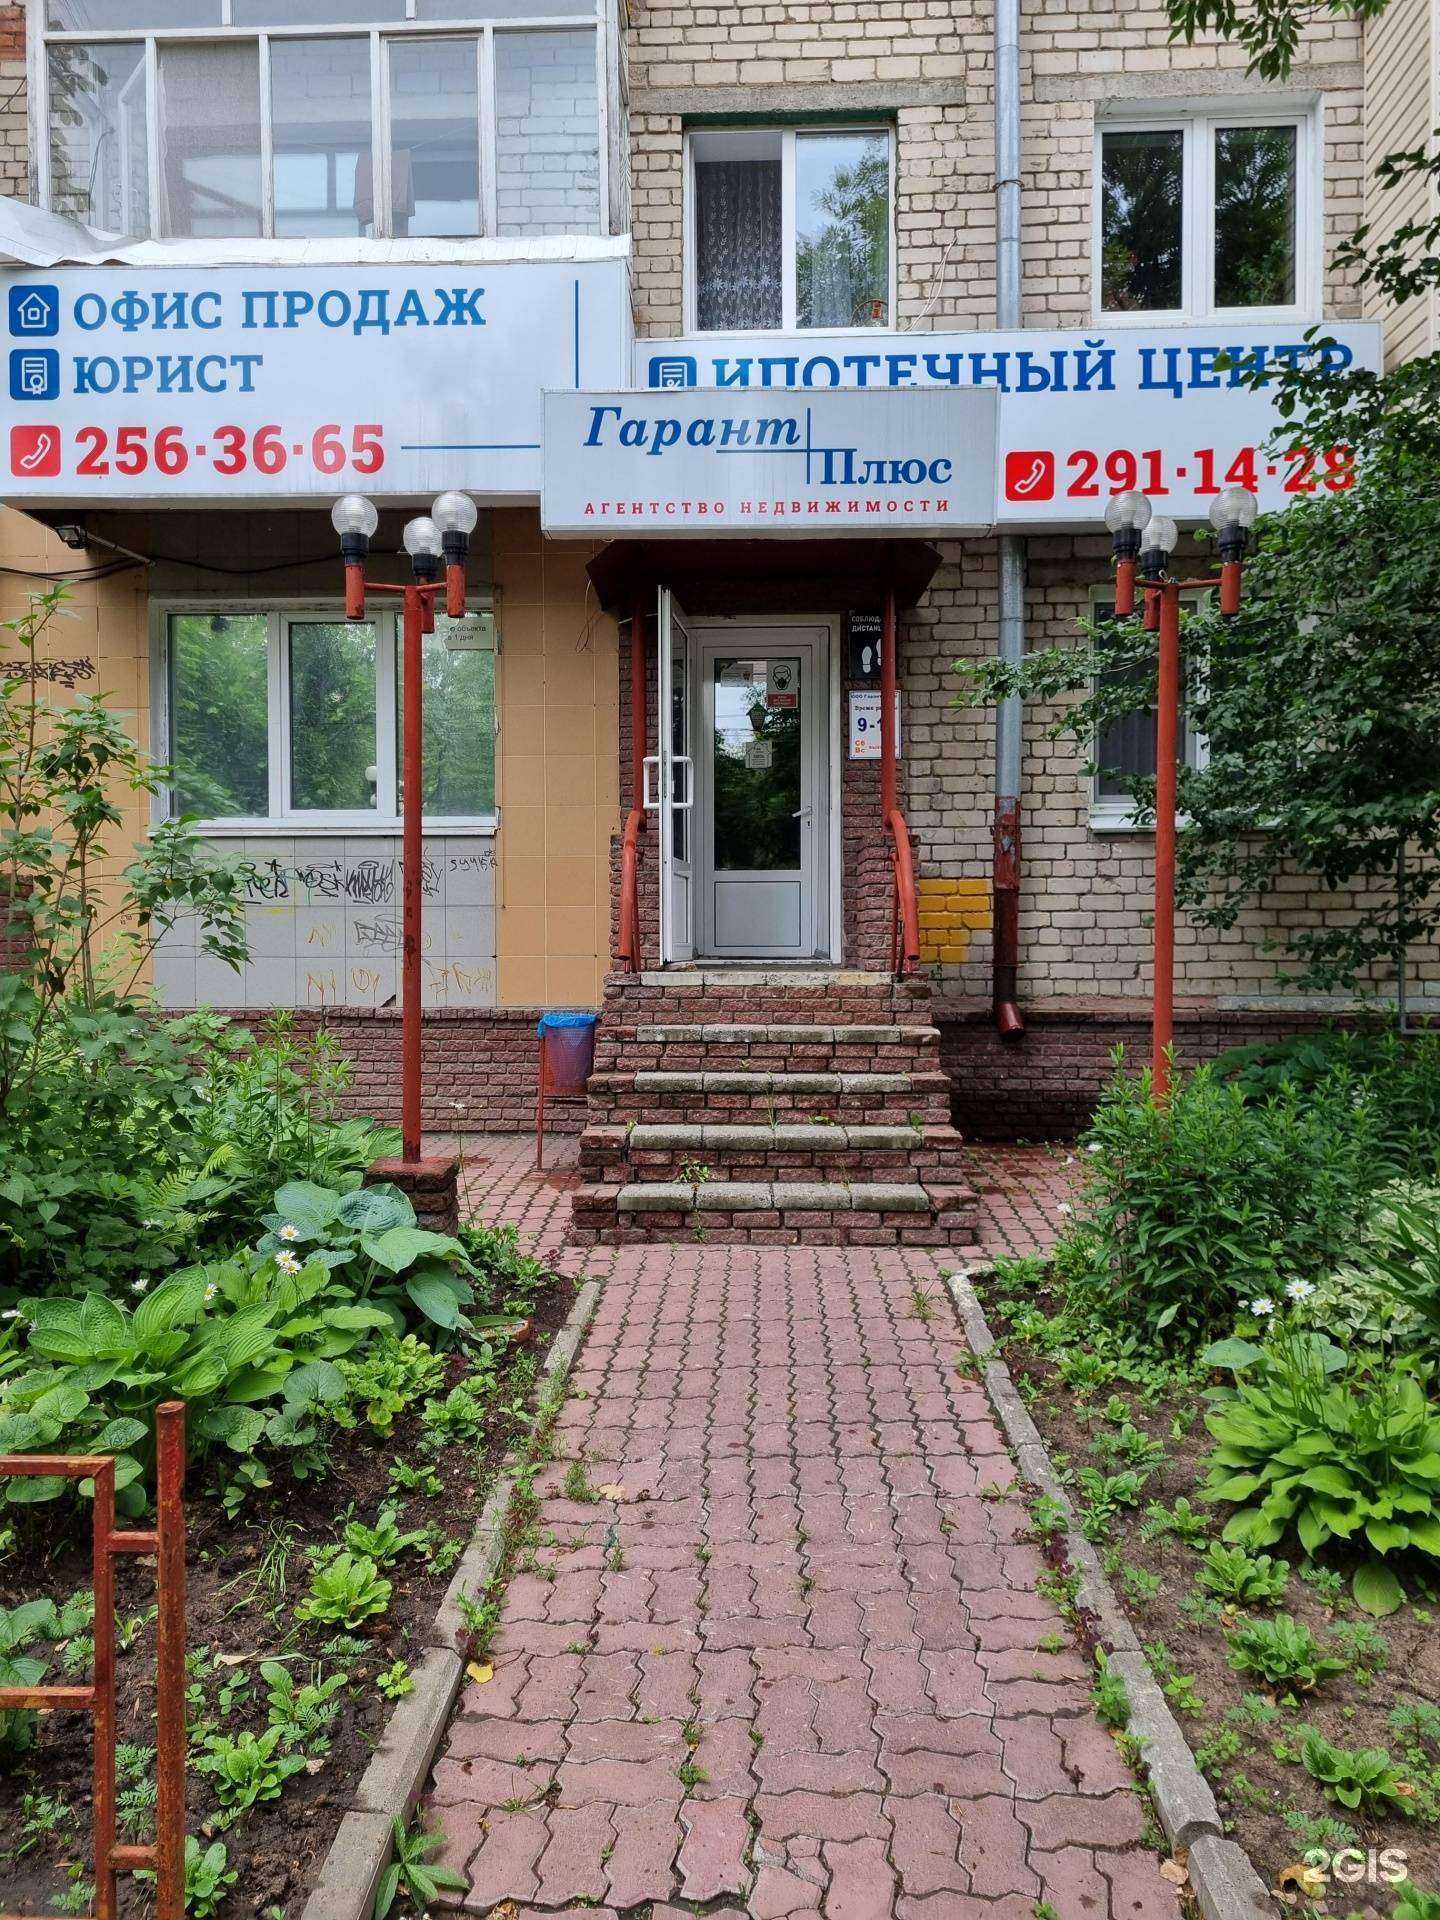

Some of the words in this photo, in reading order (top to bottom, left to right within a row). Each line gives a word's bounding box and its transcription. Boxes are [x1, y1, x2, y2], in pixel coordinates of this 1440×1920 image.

[73, 290, 222, 331] ОФИС
[241, 287, 487, 335] ПРОДАЖ
[73, 354, 263, 394] ЮРИСТ
[711, 338, 1116, 393] ИПОТЕЧНЫЙ
[583, 406, 801, 456] Гарант
[819, 448, 953, 485] Плюс
[584, 501, 725, 515] АГЕНТСТВО
[740, 499, 949, 516] НЕДВИЖИМОСТИ
